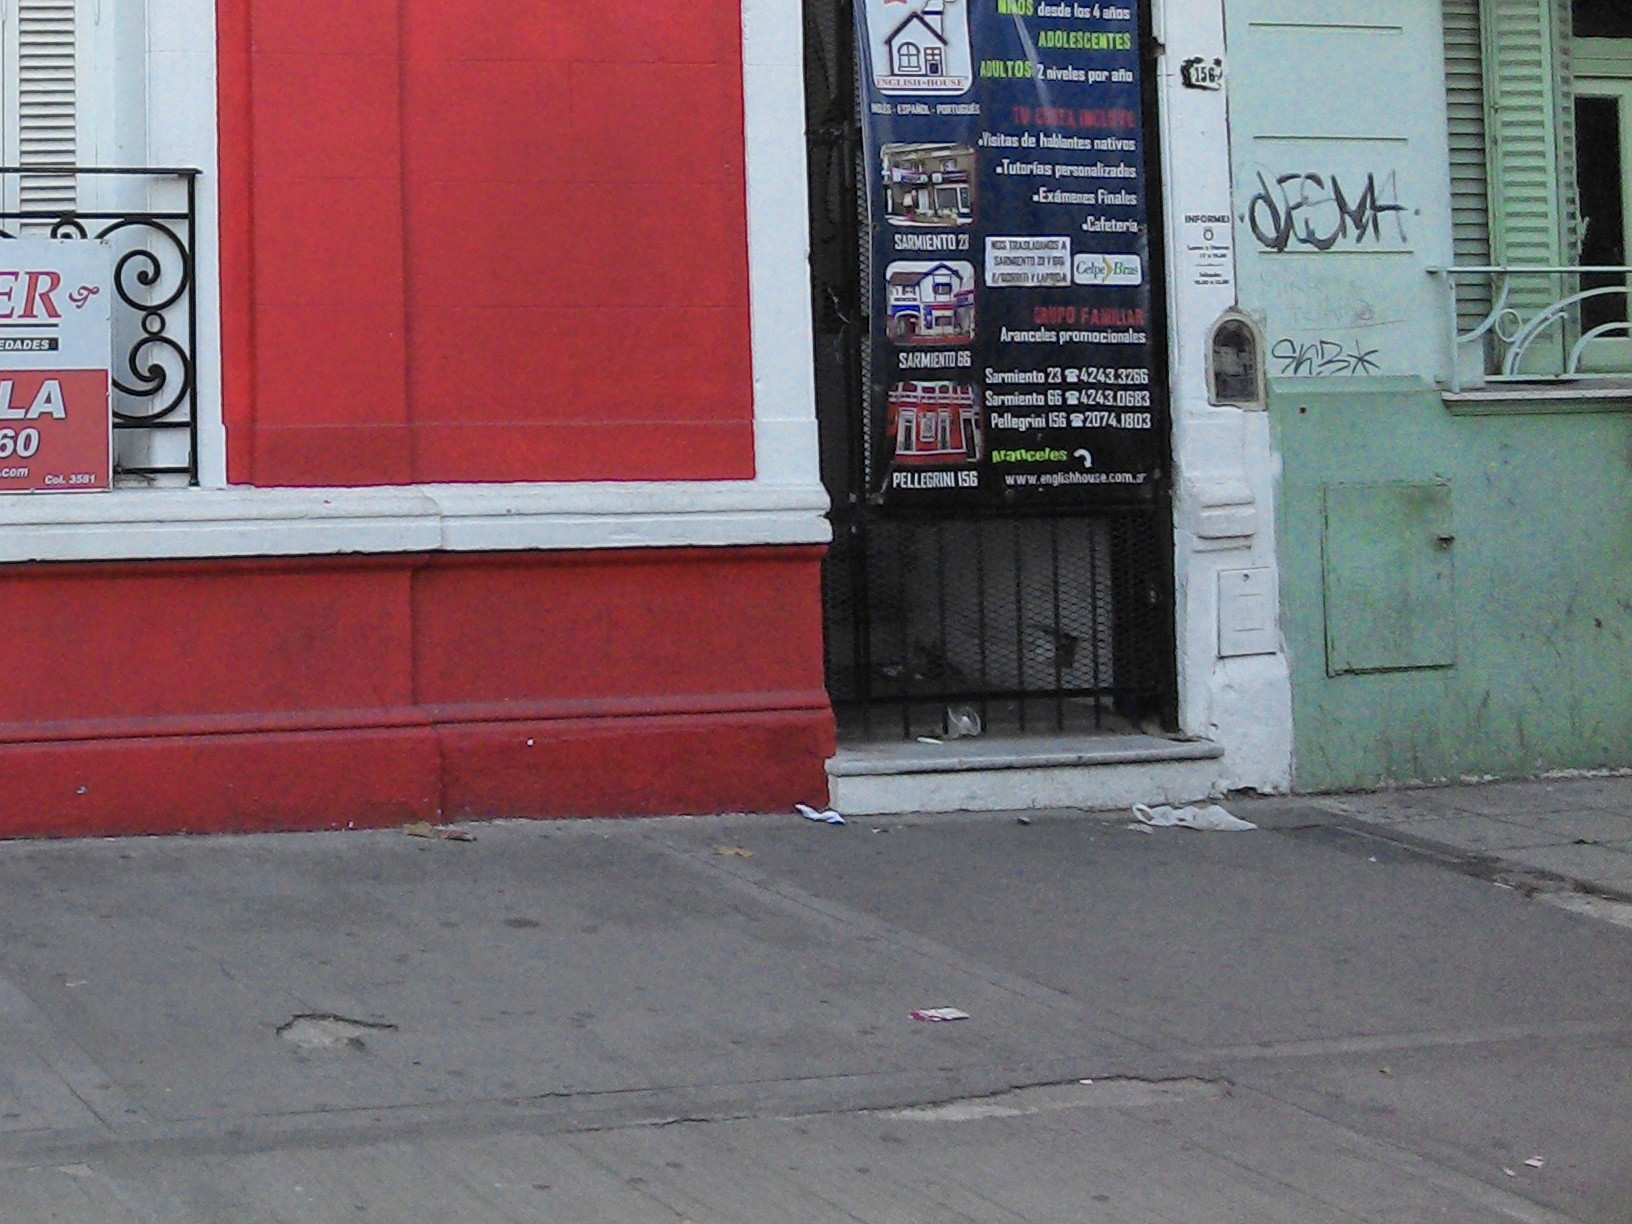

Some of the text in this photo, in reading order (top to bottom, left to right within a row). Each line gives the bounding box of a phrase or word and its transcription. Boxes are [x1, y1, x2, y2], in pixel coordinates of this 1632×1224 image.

[1037, 1, 1071, 18] desde
[1074, 2, 1090, 19] los
[1093, 3, 1100, 19] 4
[1103, 4, 1131, 20] años
[1038, 30, 1132, 50] ADOLESCENTES
[1036, 63, 1044, 79] 2
[1046, 65, 1085, 82] niveles
[1088, 69, 1109, 84] por
[1111, 67, 1133, 82] año
[1194, 66, 1216, 83] 156
[982, 131, 1136, 151] Visitas de hablantes nativos
[1002, 158, 1137, 179] Tutorías personalizadas
[1039, 187, 1137, 205] Exámenes Finales
[894, 234, 956, 250] SARMIENTO
[1000, 326, 1146, 345] Aranceles promocionales
[898, 351, 971, 369] SARMIENTO 66
[985, 367, 1149, 384] Sarmiento 23 4243.3266
[985, 389, 1150, 407] Sarmiento 66 4243.0683
[991, 411, 1151, 431] Pellegrini 156 2074.1803
[893, 471, 978, 488] PELLEGRINI 156
